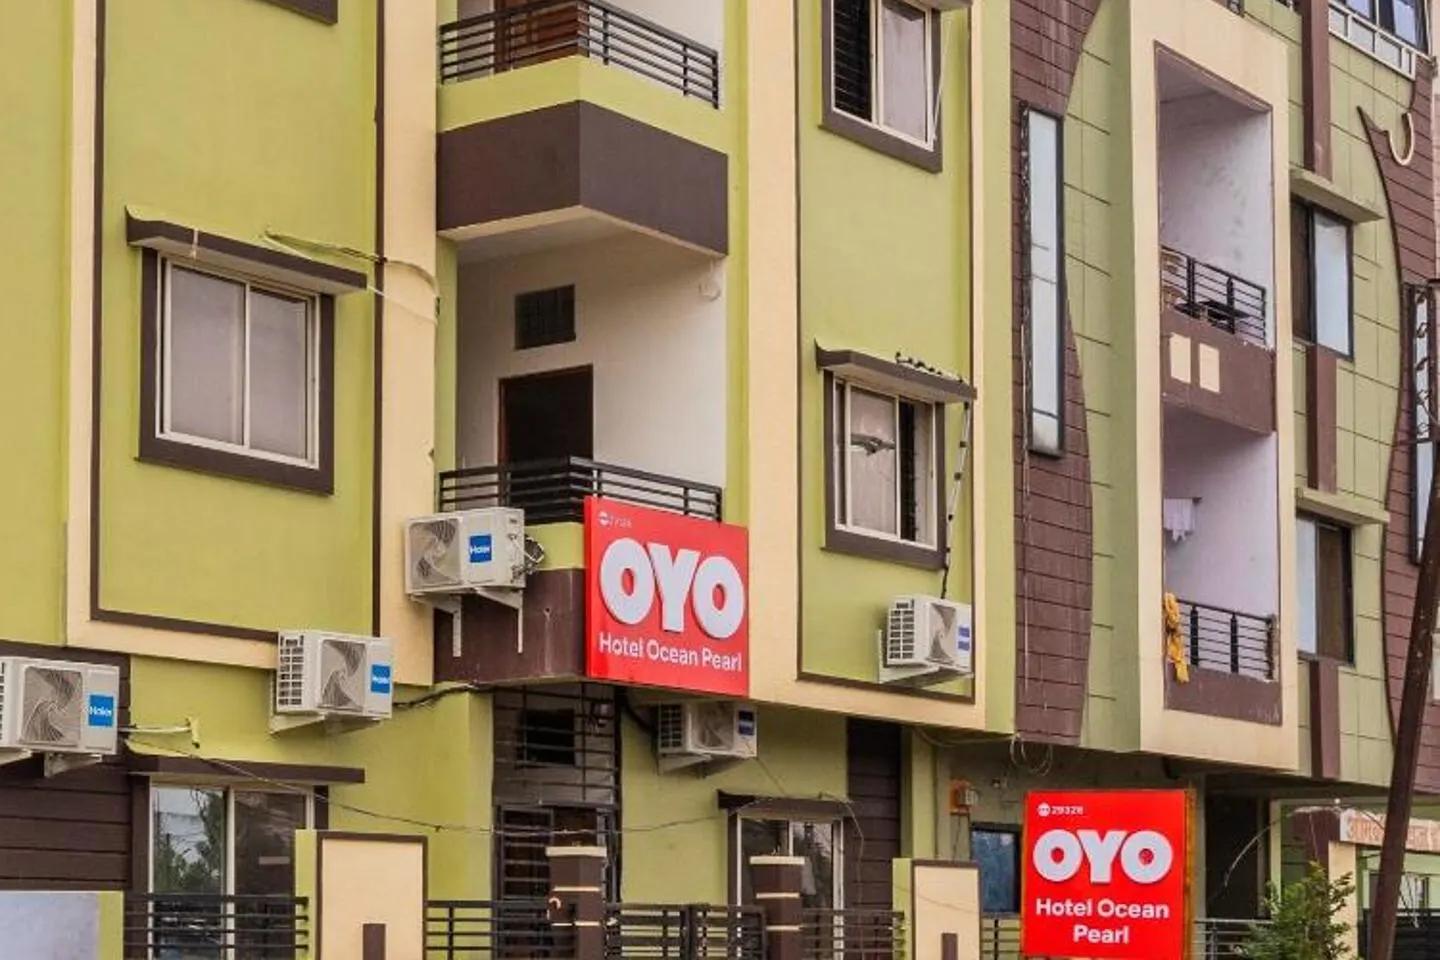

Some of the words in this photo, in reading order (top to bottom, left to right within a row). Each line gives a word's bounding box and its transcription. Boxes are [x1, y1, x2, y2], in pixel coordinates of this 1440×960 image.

[600, 537, 745, 639] OYO
[599, 632, 644, 658] Hotel
[647, 639, 698, 666] Ocean
[702, 647, 742, 672] Pearl
[1033, 828, 1174, 884] OYO
[1035, 898, 1092, 917] Hotel
[1097, 898, 1169, 919] Ocean
[1073, 924, 1129, 944] Pearl
